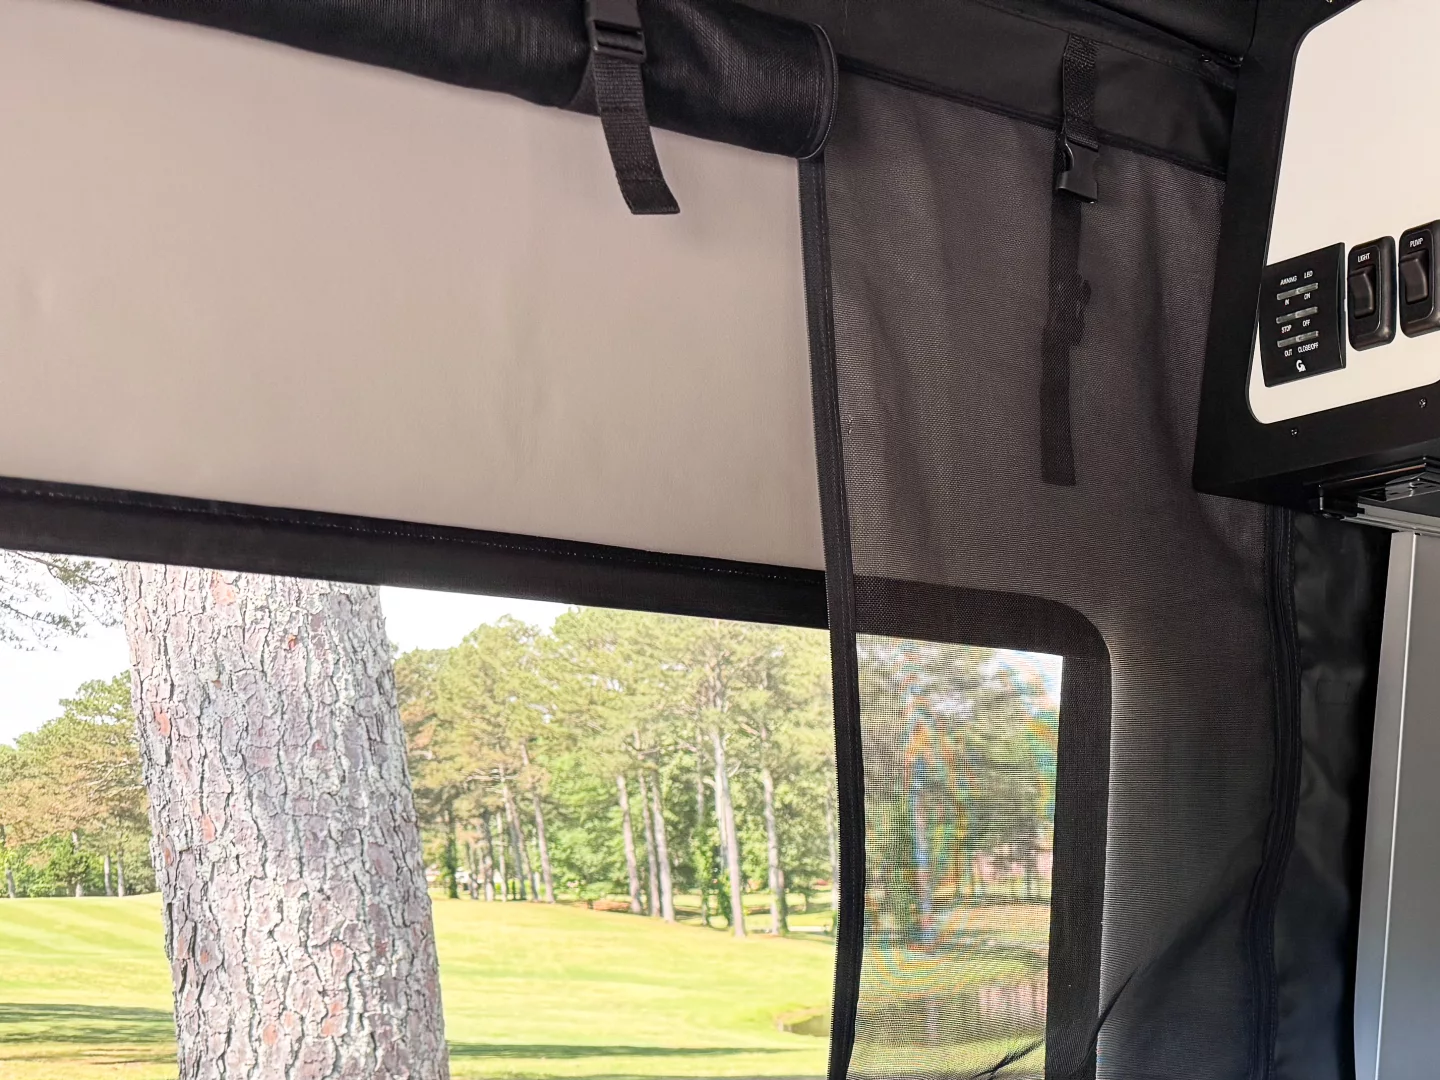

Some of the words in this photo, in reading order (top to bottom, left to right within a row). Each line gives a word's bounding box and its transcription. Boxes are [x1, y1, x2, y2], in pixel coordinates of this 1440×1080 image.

[1409, 237, 1424, 248] PUMP
[1357, 252, 1371, 263] LIGHT
[1303, 270, 1315, 279] LED
[1280, 275, 1298, 286] AWNING
[1303, 292, 1311, 300] ON
[1284, 298, 1290, 306] IN
[1302, 319, 1311, 327] OFF
[1281, 324, 1292, 334] STOP
[1297, 341, 1319, 353] CLOSE/OFF
[1284, 348, 1293, 357] OUT
